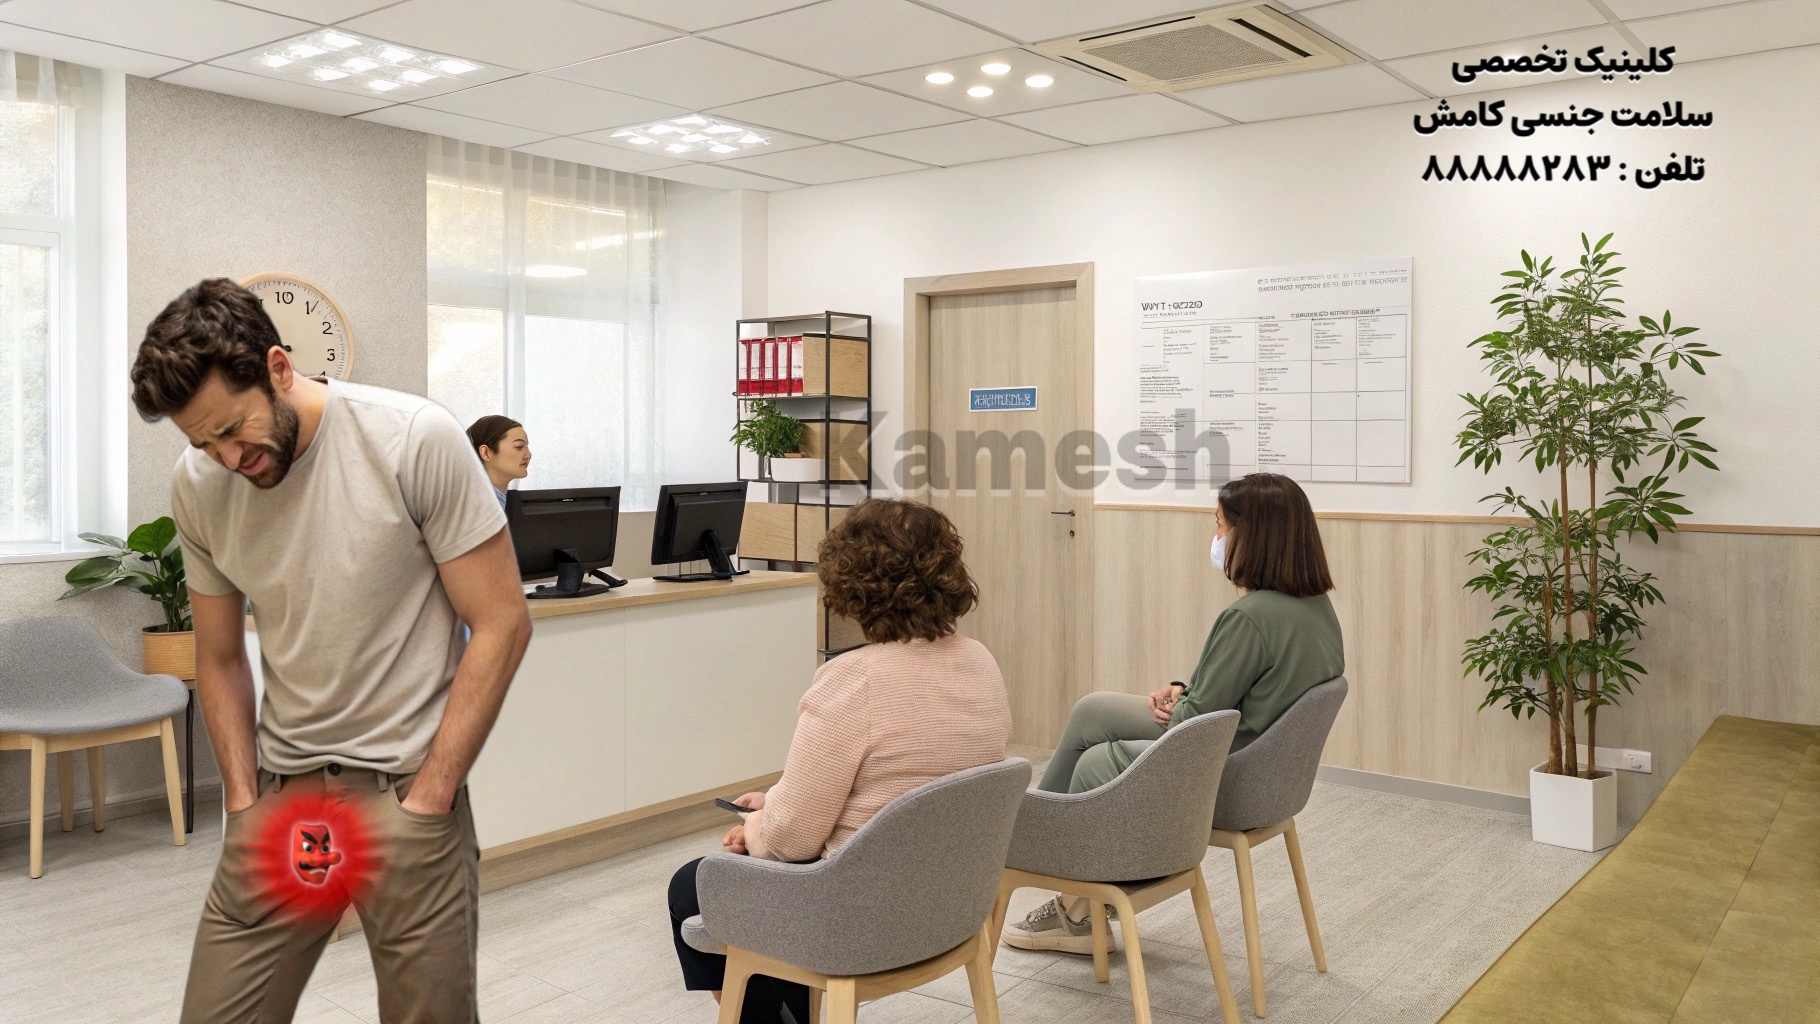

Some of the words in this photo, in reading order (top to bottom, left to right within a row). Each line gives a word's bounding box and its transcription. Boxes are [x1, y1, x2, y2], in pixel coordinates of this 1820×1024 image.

[275, 291, 294, 305] 10
[322, 321, 333, 335] 2
[326, 348, 336, 361] 3
